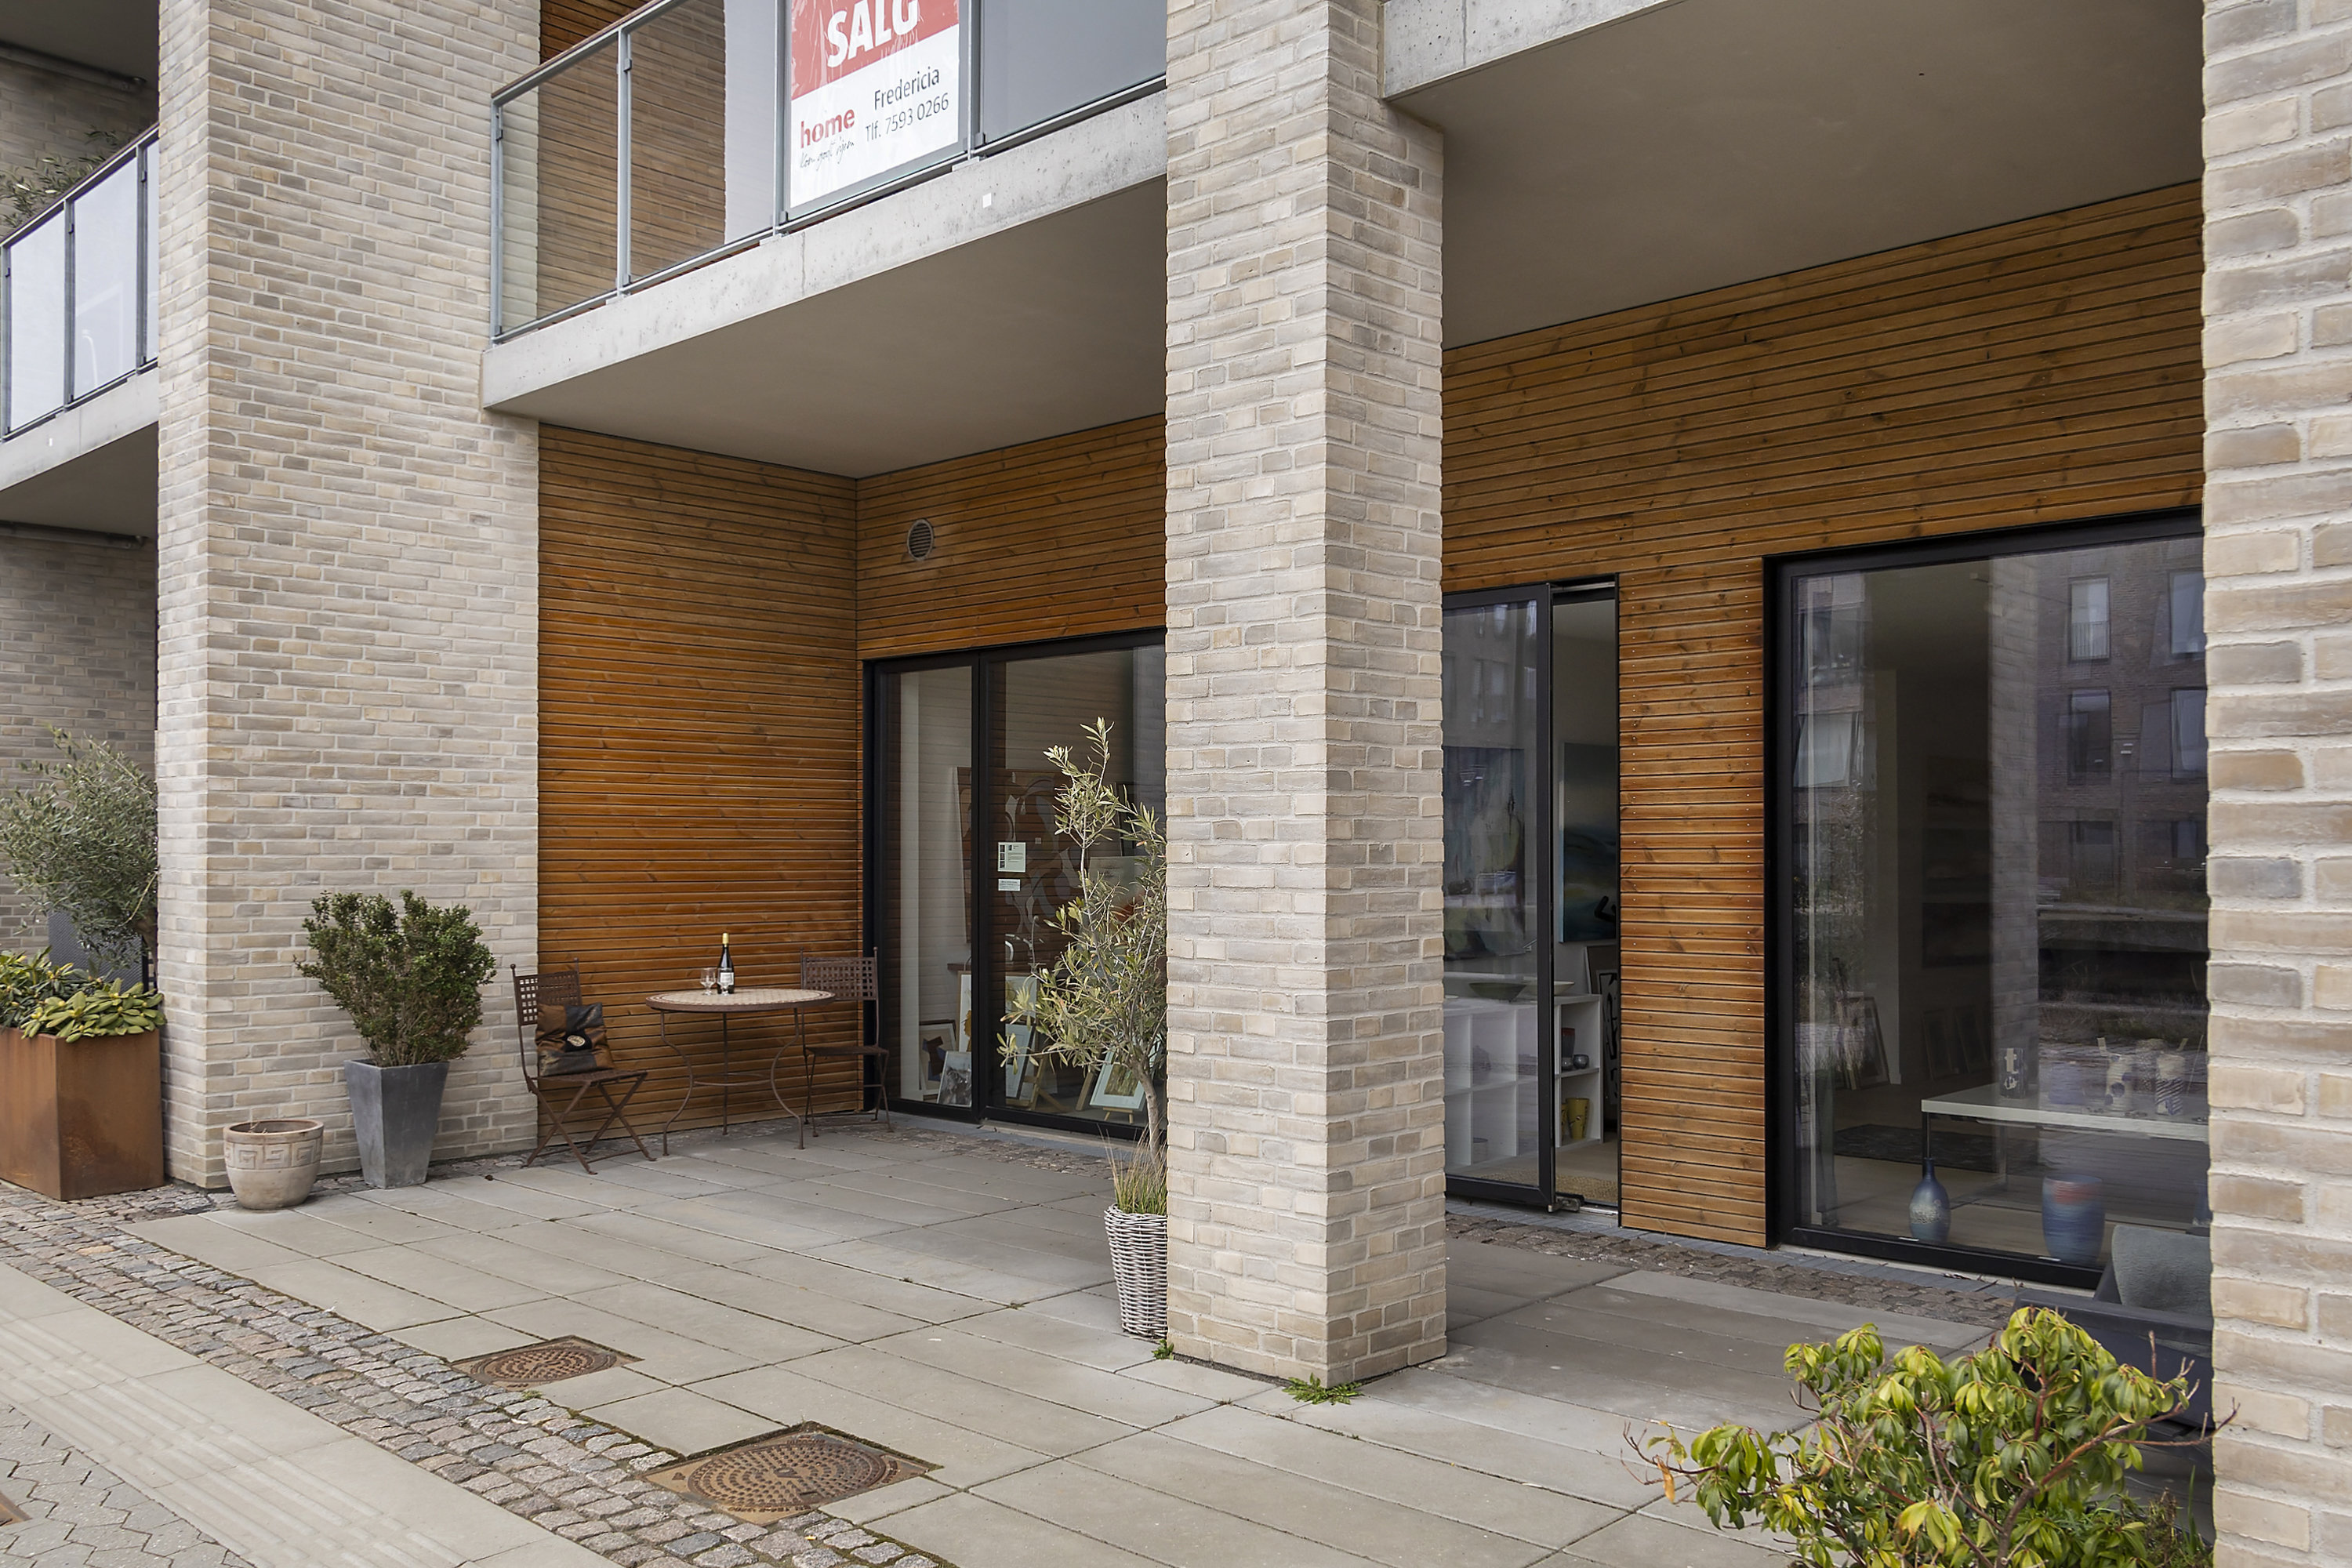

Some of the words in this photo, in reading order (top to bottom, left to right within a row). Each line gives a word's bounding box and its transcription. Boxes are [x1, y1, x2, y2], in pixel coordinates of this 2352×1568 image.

[827, 0, 918, 67] SALG
[874, 67, 940, 111] Fredericia
[800, 109, 855, 149] home
[865, 121, 881, 142] Tlf.
[885, 108, 913, 135] 7593
[916, 93, 949, 120] 0266
